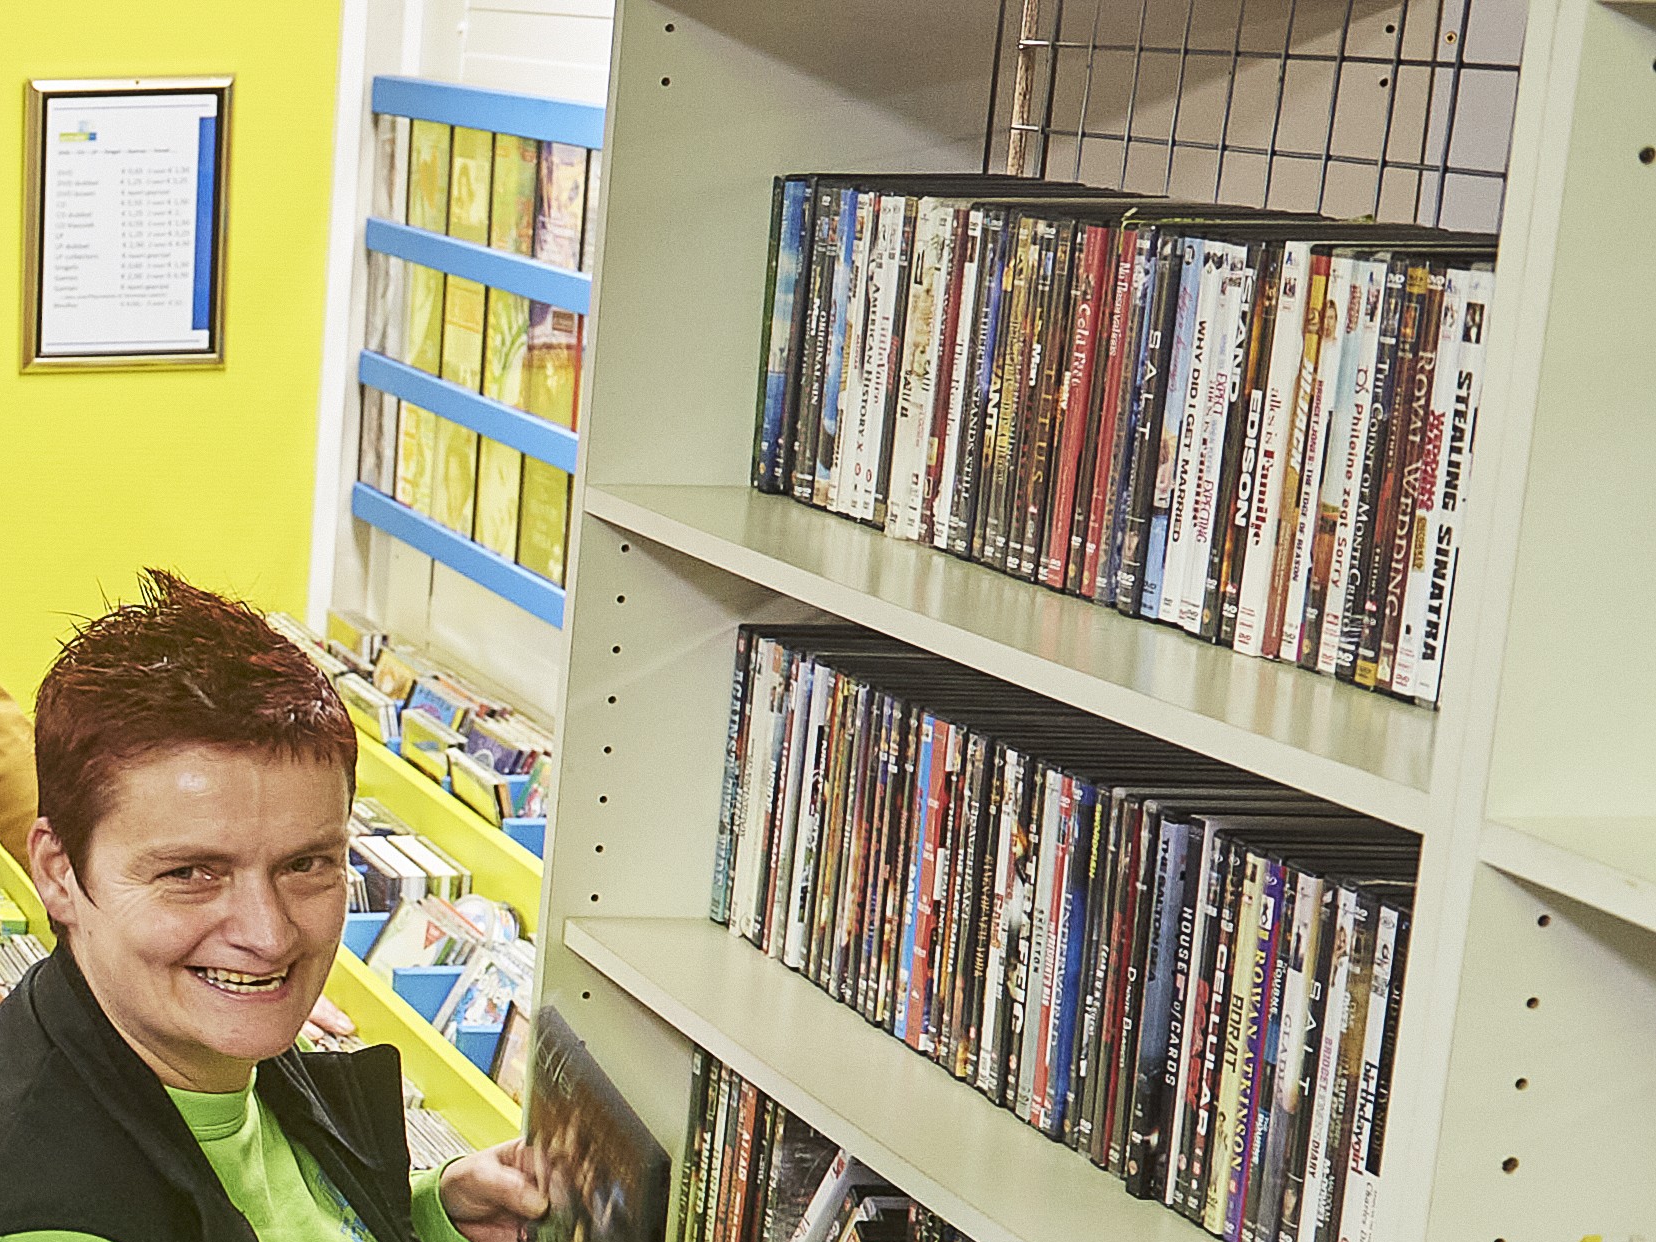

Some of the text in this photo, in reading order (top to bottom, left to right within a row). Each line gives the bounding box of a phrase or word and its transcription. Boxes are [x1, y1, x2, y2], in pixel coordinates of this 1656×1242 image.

[1118, 262, 1131, 279] No
[812, 310, 829, 377] ORIGINAL
[856, 283, 883, 438] AMERICAN HISTORY
[1071, 302, 1092, 388] Cold Feet
[1138, 330, 1162, 441] SALT
[945, 376, 962, 438] Reader
[967, 384, 983, 452] STANDS
[1031, 363, 1057, 485] TITUS
[1171, 319, 1208, 543] WHY DID GET MARRIED
[1195, 371, 1228, 544] EXPECT EXPECTING
[1234, 388, 1263, 528] EDISON
[1266, 386, 1282, 429] alles
[1288, 356, 1314, 477] HIJACK
[1362, 402, 1385, 469] COUNT
[1292, 379, 1325, 583] BRIDGET THE EDGE REASON
[1330, 402, 1366, 589] Phileine zegt Sorry
[1350, 502, 1371, 568] MONTE
[1383, 350, 1436, 617] ROYAL WEDDING
[1421, 369, 1474, 662] STEALING SINATRA
[1009, 854, 1037, 1036] TRAFFIC
[1032, 906, 1045, 975] SKELETON
[1050, 891, 1074, 1048] UNDERWORLD
[1163, 906, 1194, 1087] HOUSE of CARDS
[1269, 958, 1285, 1016] BOURNE
[1196, 943, 1229, 1137] CELLULAR
[1224, 993, 1244, 1074] BORAT
[1230, 947, 1267, 1172] ROWAN ATKINSON
[1296, 978, 1322, 1096] SALT
[1253, 1112, 1267, 1165] BOURNE
[1307, 1035, 1333, 1179] BRIDGET DIARY
[1349, 1060, 1379, 1177] birthdaygirl
[693, 1130, 712, 1214] TWISTED
